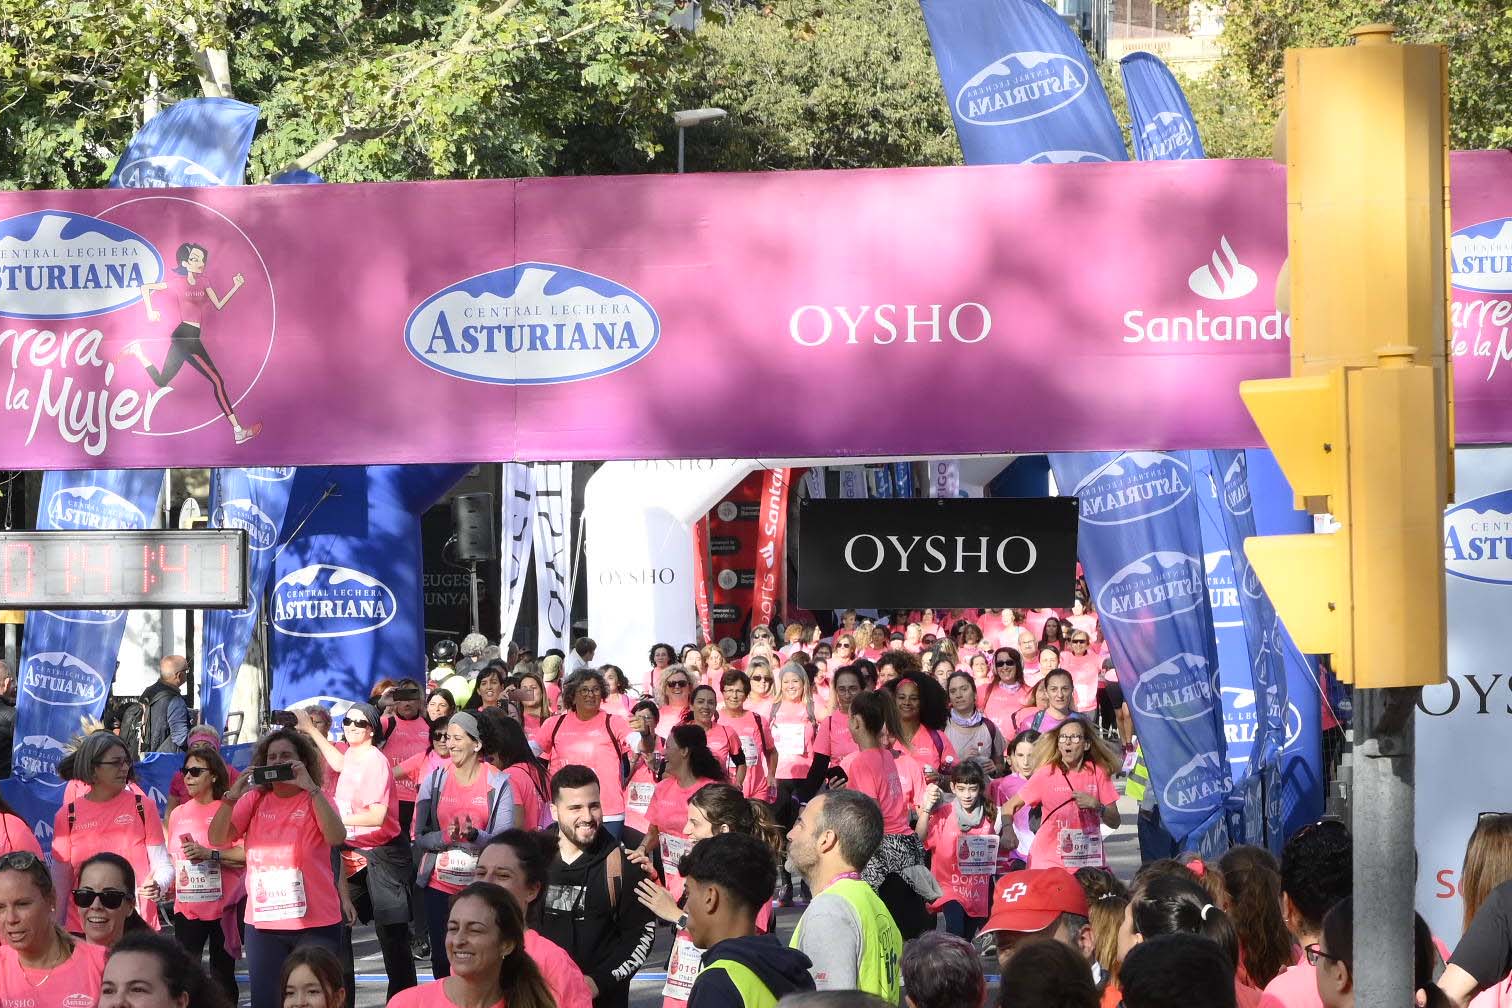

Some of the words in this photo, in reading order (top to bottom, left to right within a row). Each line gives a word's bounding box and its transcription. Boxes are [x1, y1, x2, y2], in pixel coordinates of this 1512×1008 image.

[67, 245, 140, 259] LECHERA
[463, 303, 542, 318] CENTRAL
[550, 302, 632, 317] LECHERA
[424, 309, 640, 354] ASTURIANA
[788, 302, 992, 346] OYSHO
[4, 371, 30, 410] la
[25, 363, 176, 456] Mujer
[843, 533, 1039, 577] OYSHO
[287, 589, 329, 598] CENTRAL
[334, 589, 383, 598] LECHERA
[274, 593, 388, 621] ASTURIANA
[970, 850, 985, 858] 016
[678, 963, 697, 975] 016
